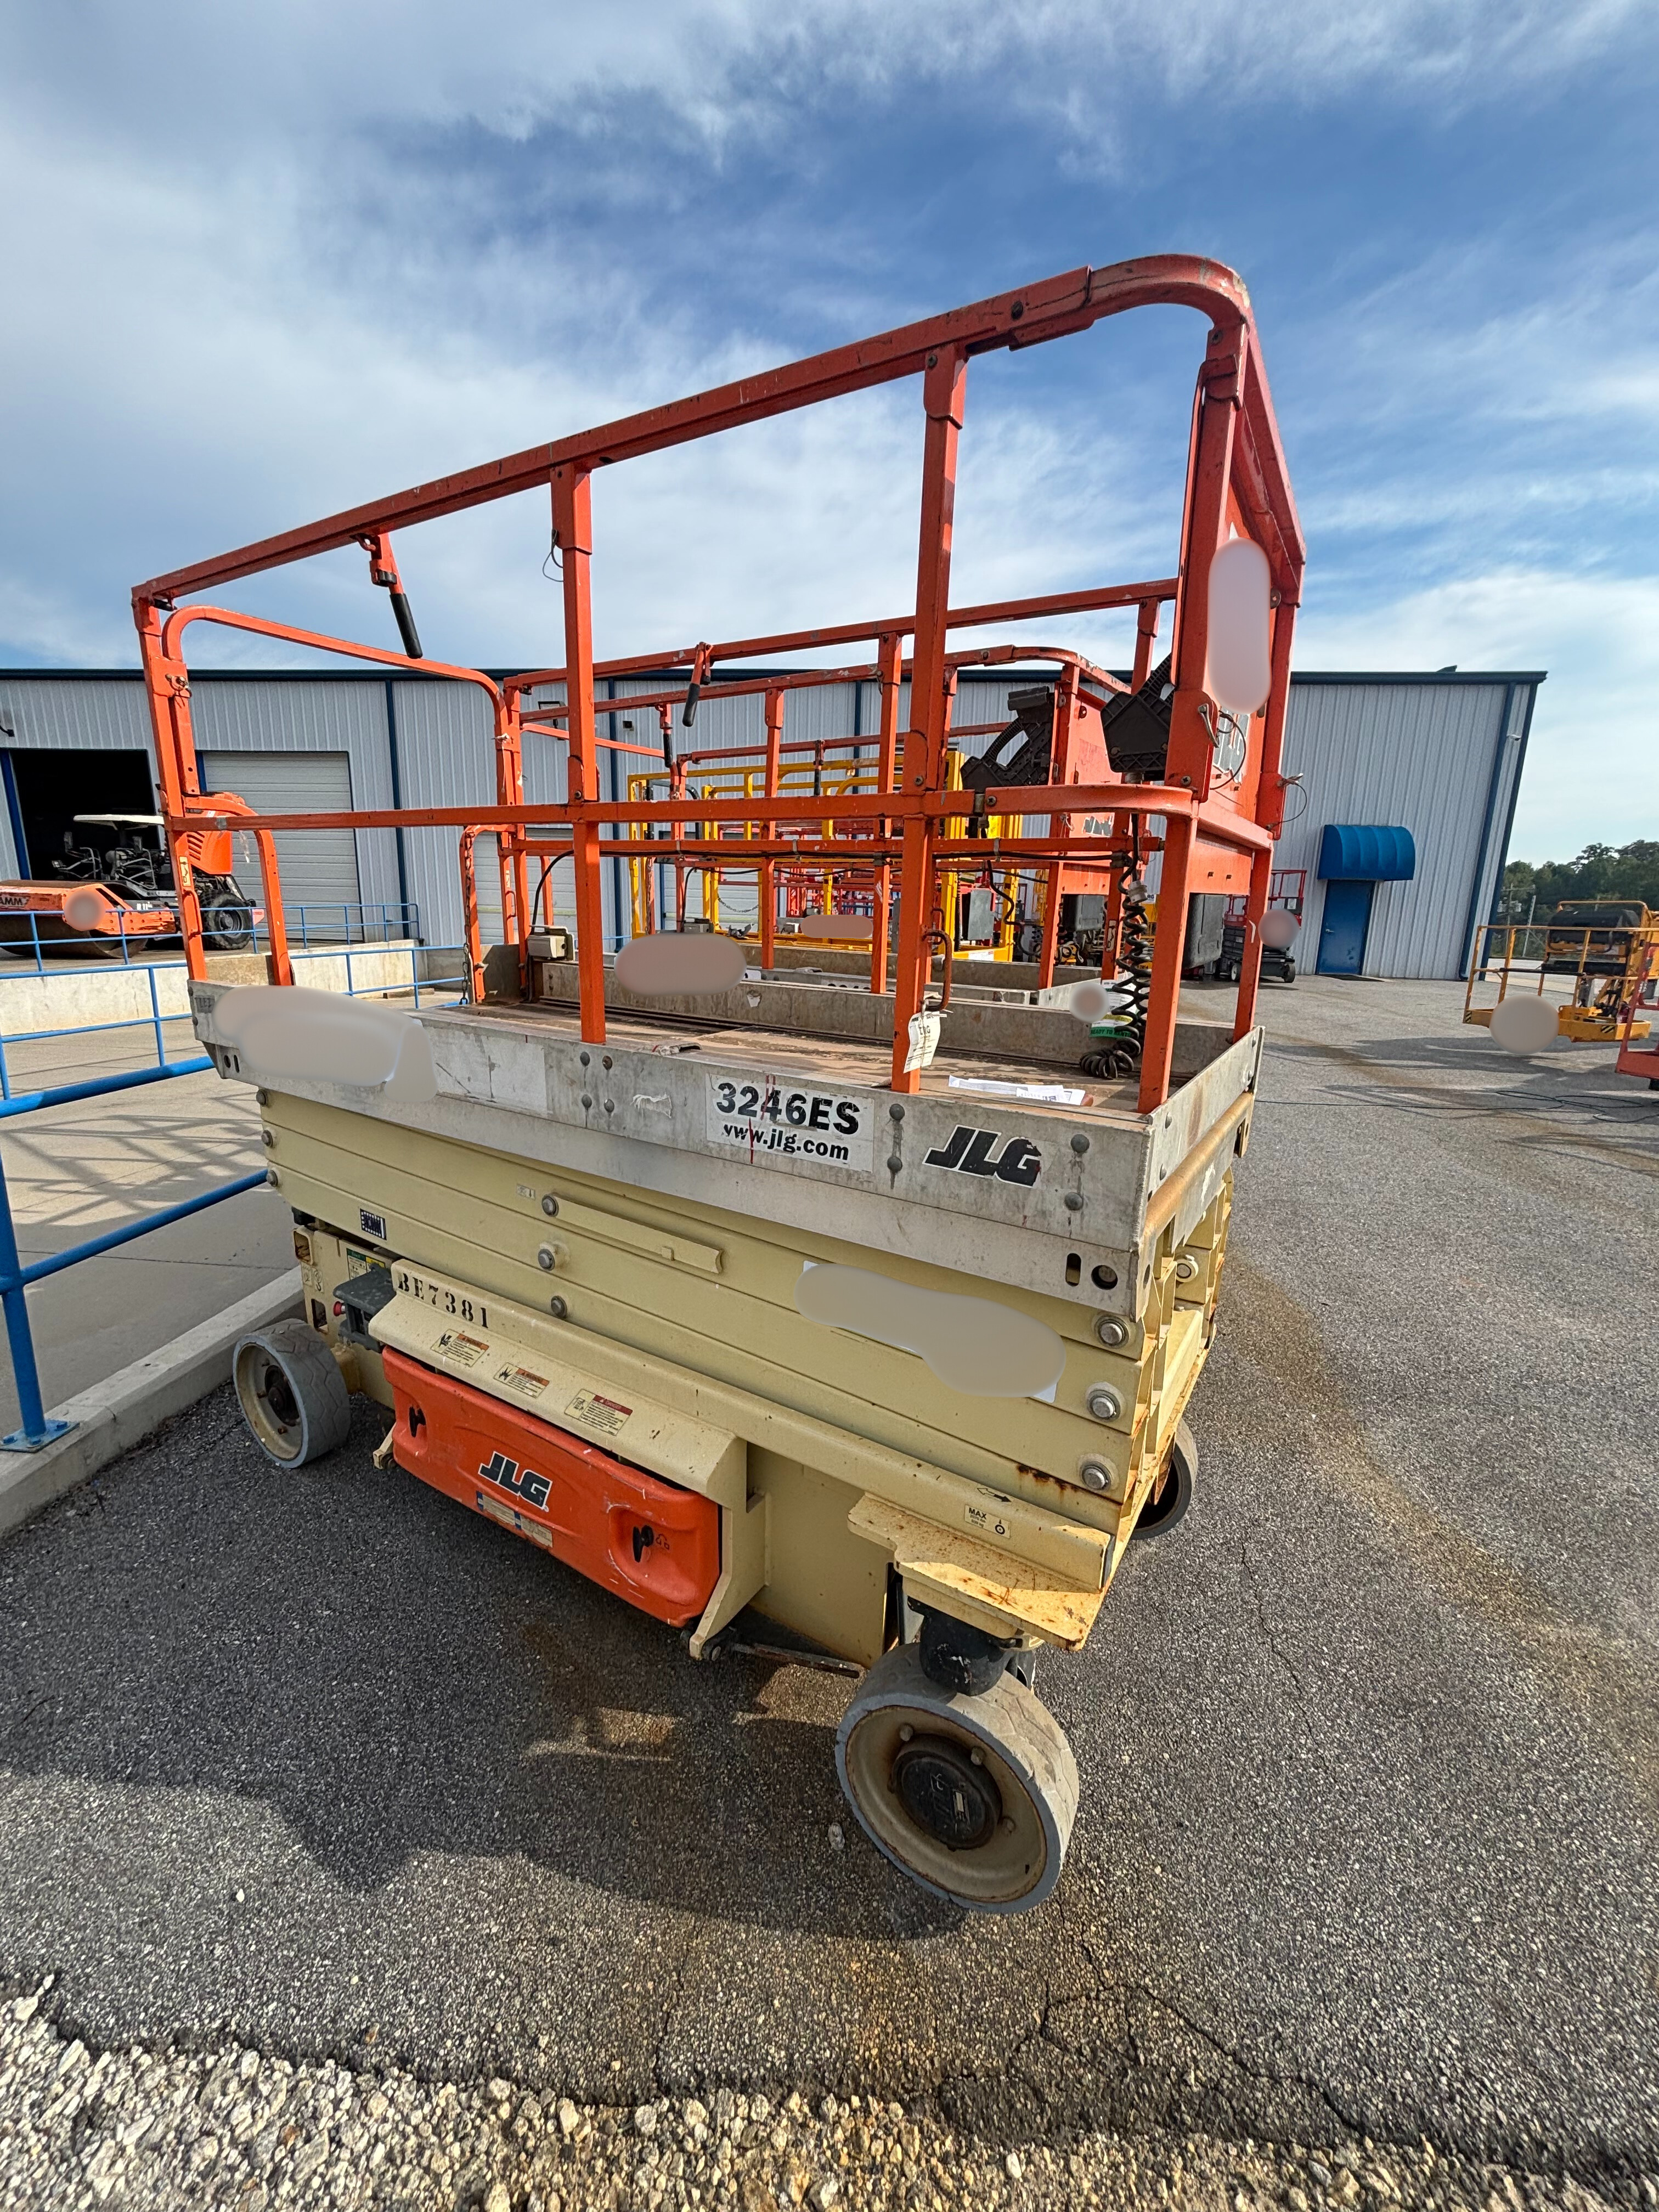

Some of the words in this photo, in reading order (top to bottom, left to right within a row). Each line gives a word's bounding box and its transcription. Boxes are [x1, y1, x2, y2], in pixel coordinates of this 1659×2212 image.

[716, 1082, 860, 1135] 3246ES
[922, 1125, 1042, 1188] JLG
[398, 1273, 488, 1329] BE7381
[477, 1451, 552, 1510] JLG
[968, 1507, 986, 1520] MAX
